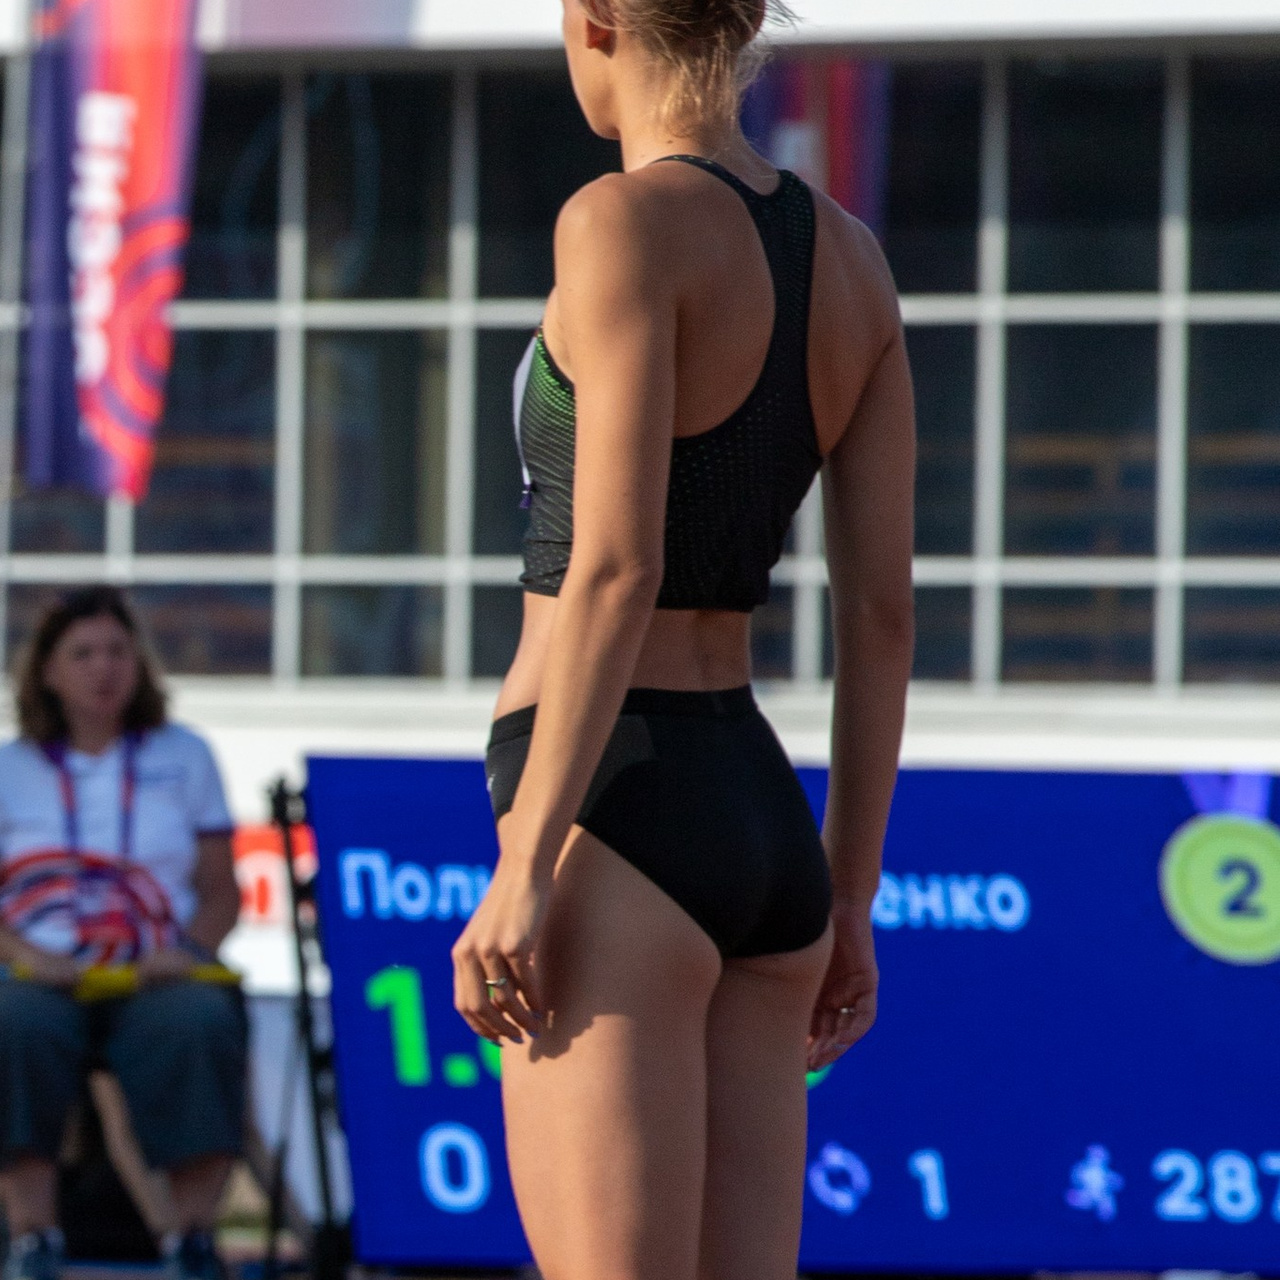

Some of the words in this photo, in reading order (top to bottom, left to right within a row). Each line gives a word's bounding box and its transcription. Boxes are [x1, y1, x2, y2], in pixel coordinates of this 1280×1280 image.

[870, 869, 1032, 932] енко
[1217, 856, 1267, 918] 2
[365, 964, 503, 1088] 1.
[419, 1121, 493, 1214] 0
[907, 1147, 951, 1220] 1
